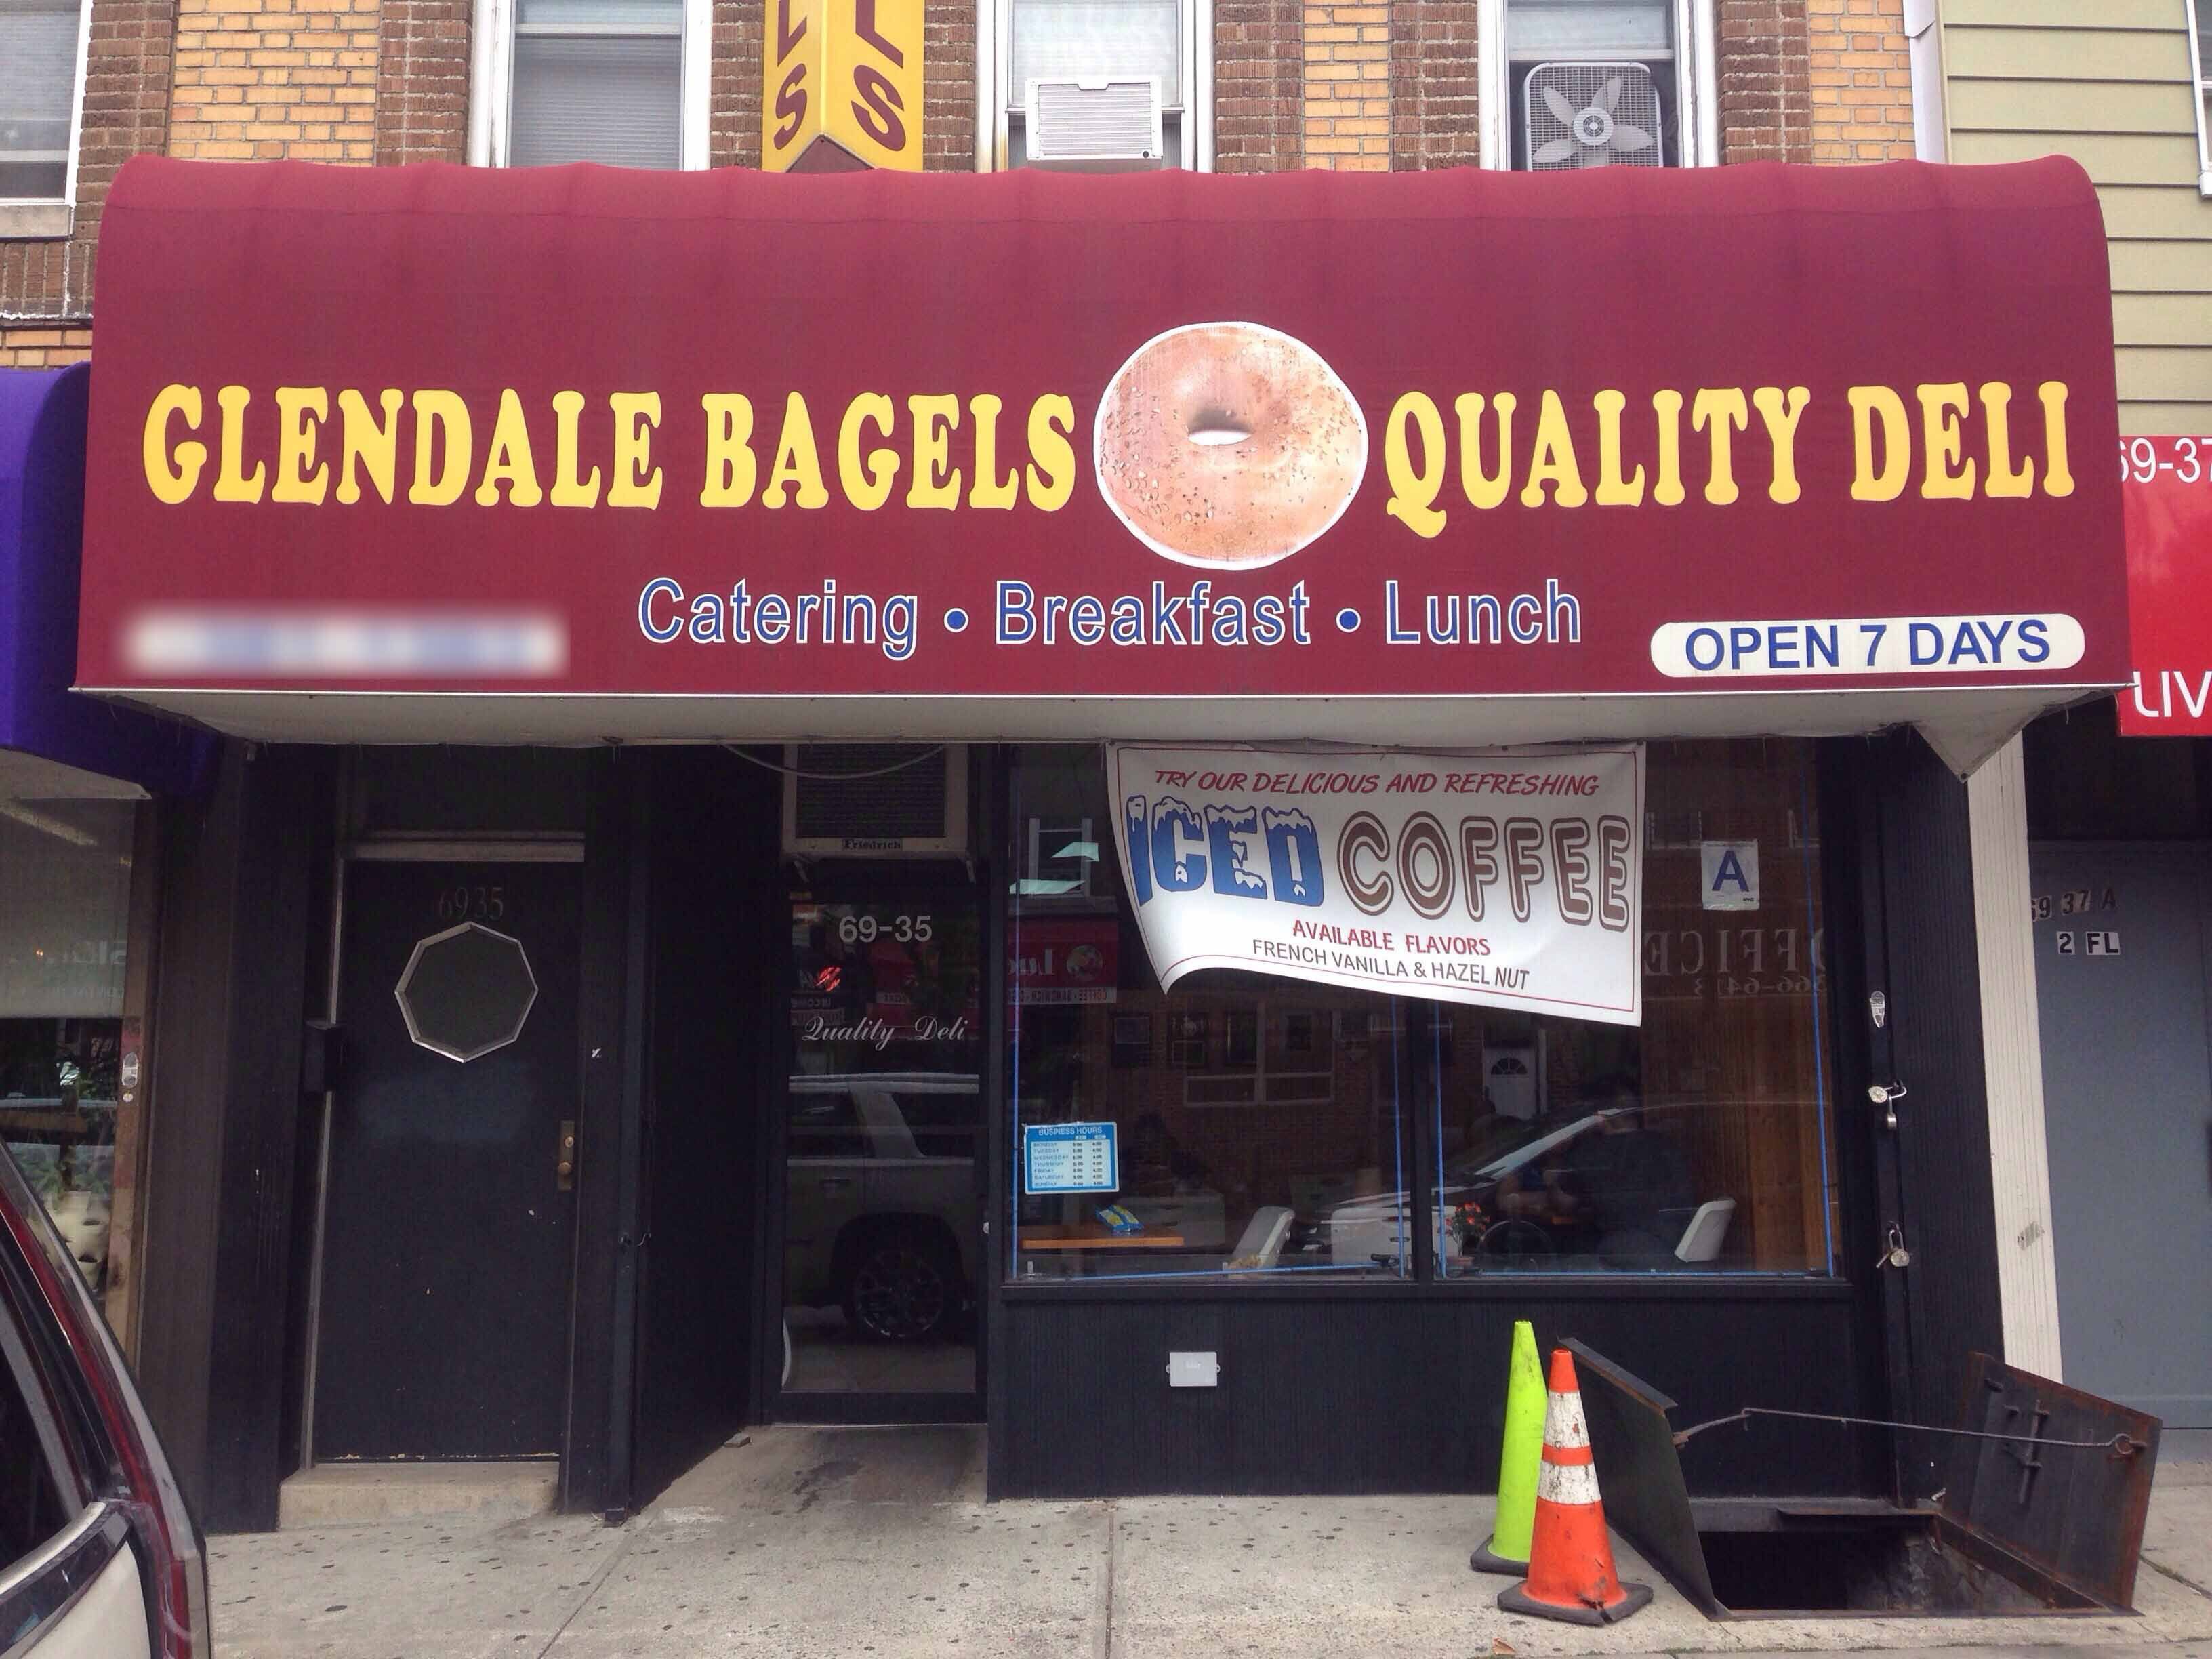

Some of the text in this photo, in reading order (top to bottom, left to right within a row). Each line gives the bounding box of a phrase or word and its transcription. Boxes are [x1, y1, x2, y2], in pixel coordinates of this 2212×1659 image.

[143, 384, 1076, 512] GLENDALE BAGELS
[1385, 380, 2076, 539] QUALITY DELI
[638, 578, 918, 661] Catering
[995, 580, 1311, 646] Breakfast
[1385, 579, 1582, 644] Lunch
[1685, 619, 2051, 671] OPEN 7 DAYS
[2132, 670, 2212, 718] LIV
[1155, 770, 1599, 796] TRY OUR DELICIOUS AND REFRESHING
[1126, 795, 1631, 933] ICED COFFEE
[1712, 851, 1750, 893] A
[2102, 888, 2116, 910] A
[839, 915, 933, 943] 69-35
[1293, 920, 1491, 956] AVAILABLE FLAVORS
[2058, 933, 2119, 954] 2 FL
[1252, 939, 1530, 991] FRENCH VANILLA & HAZEL NUT
[802, 1017, 895, 1050] Quality
[915, 1016, 968, 1041] Deli
[1039, 1126, 1103, 1136] BUSINESS HOURS
